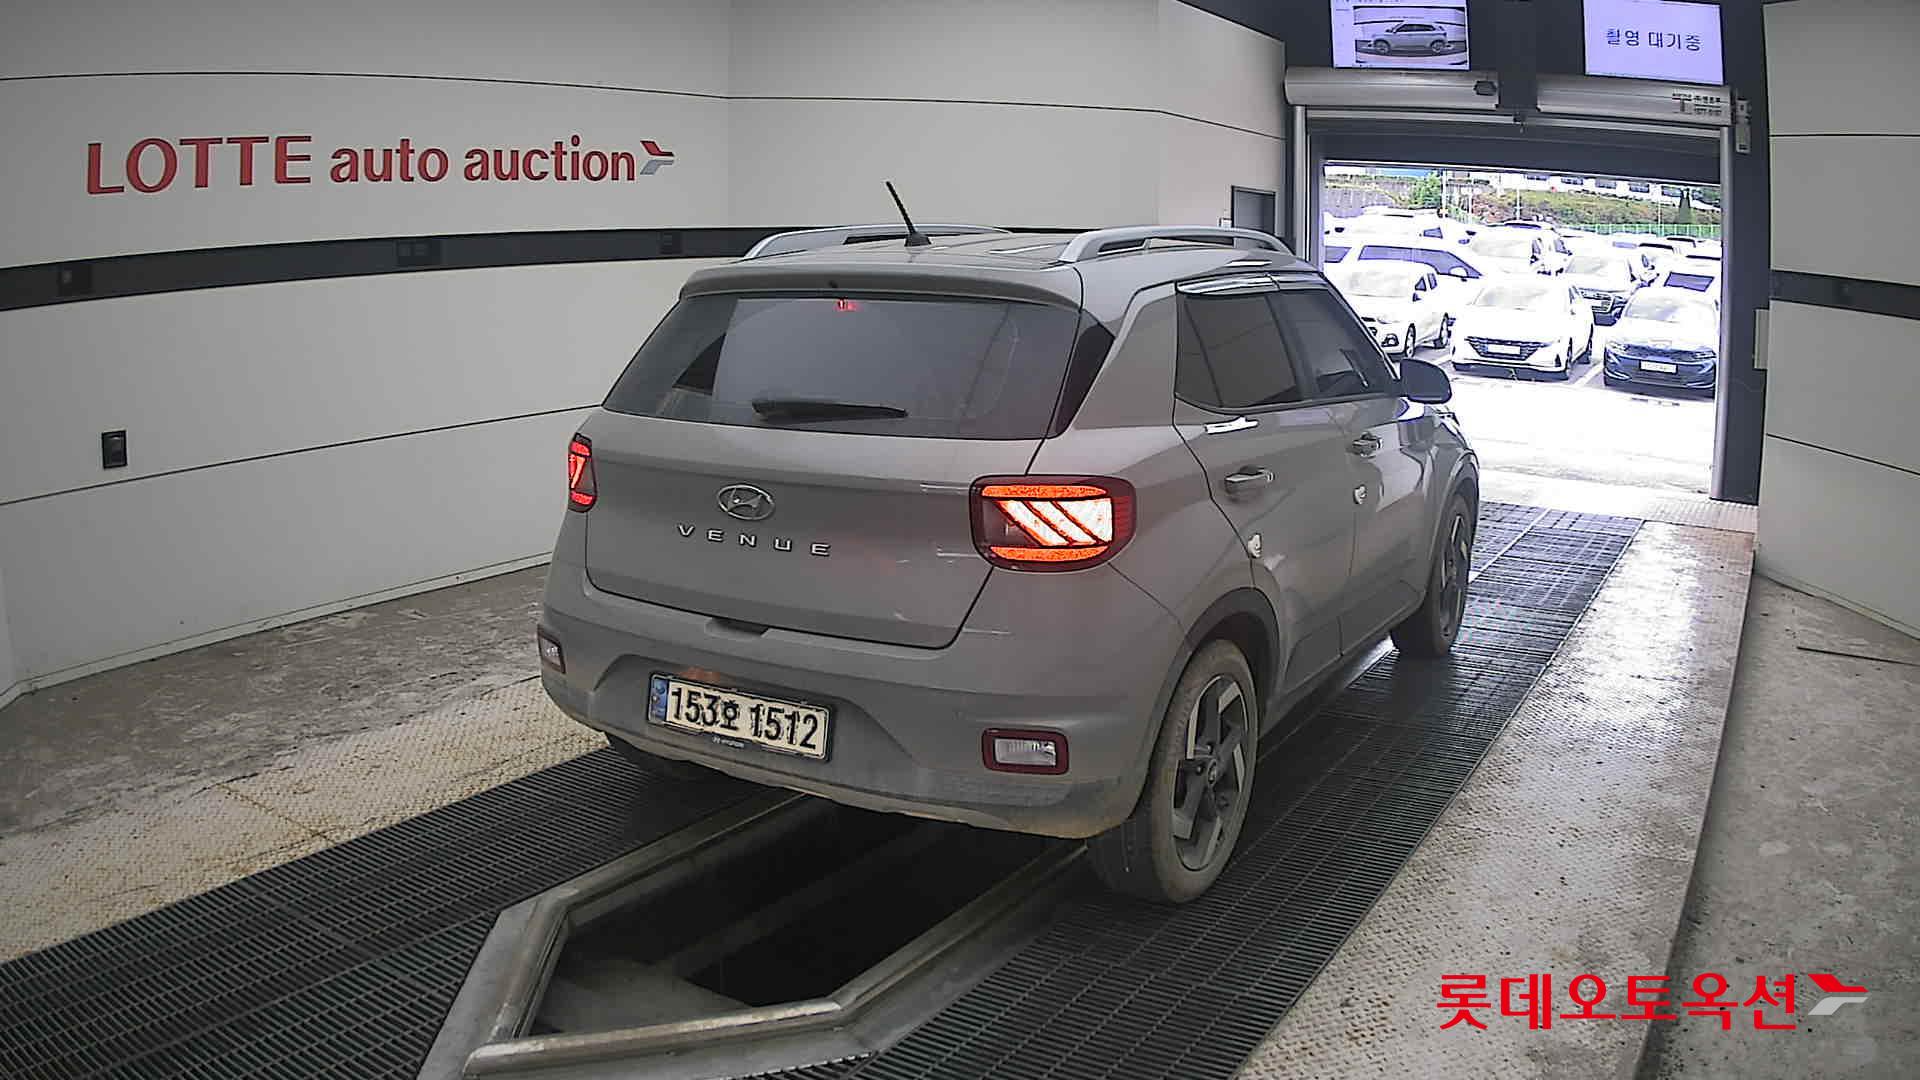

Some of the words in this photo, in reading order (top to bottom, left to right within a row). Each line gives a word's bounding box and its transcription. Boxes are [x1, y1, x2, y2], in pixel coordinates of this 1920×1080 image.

[87, 136, 312, 194] LOTTE
[329, 138, 449, 183] auto
[463, 135, 636, 182] auction
[678, 525, 830, 556] VENUE
[750, 703, 819, 749] 1512
